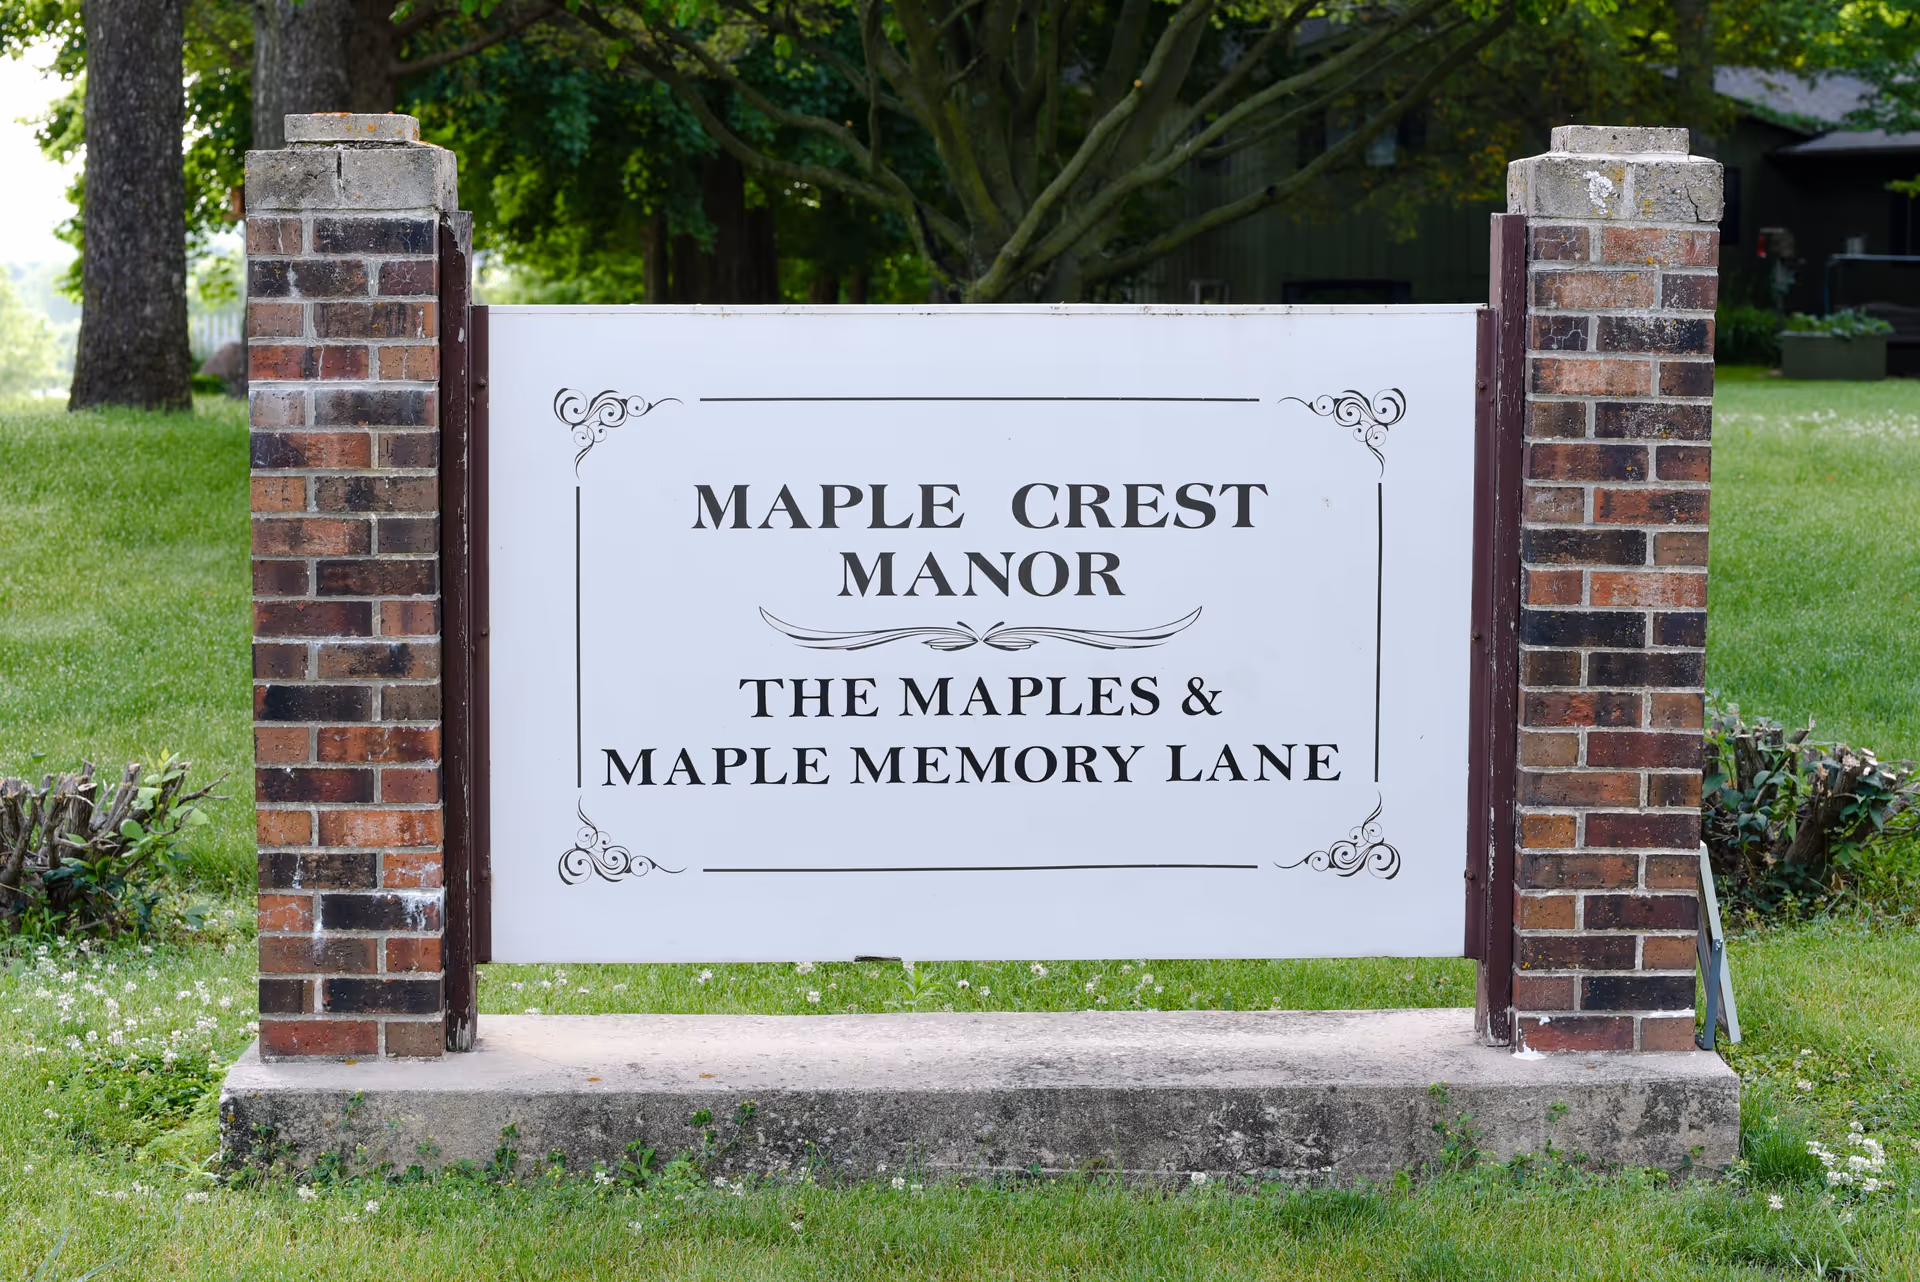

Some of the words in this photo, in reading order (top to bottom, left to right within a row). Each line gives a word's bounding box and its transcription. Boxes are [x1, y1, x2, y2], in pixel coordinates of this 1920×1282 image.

[692, 484, 964, 529] MAPLE
[1011, 483, 1268, 529] CREST
[838, 551, 1125, 597] MANOR
[738, 677, 878, 717] THE
[899, 677, 1160, 716] MAPLES
[1181, 676, 1222, 716] &
[601, 747, 829, 786] MAPLE
[850, 745, 1145, 785] MEMORY
[1166, 743, 1342, 783] LANE
